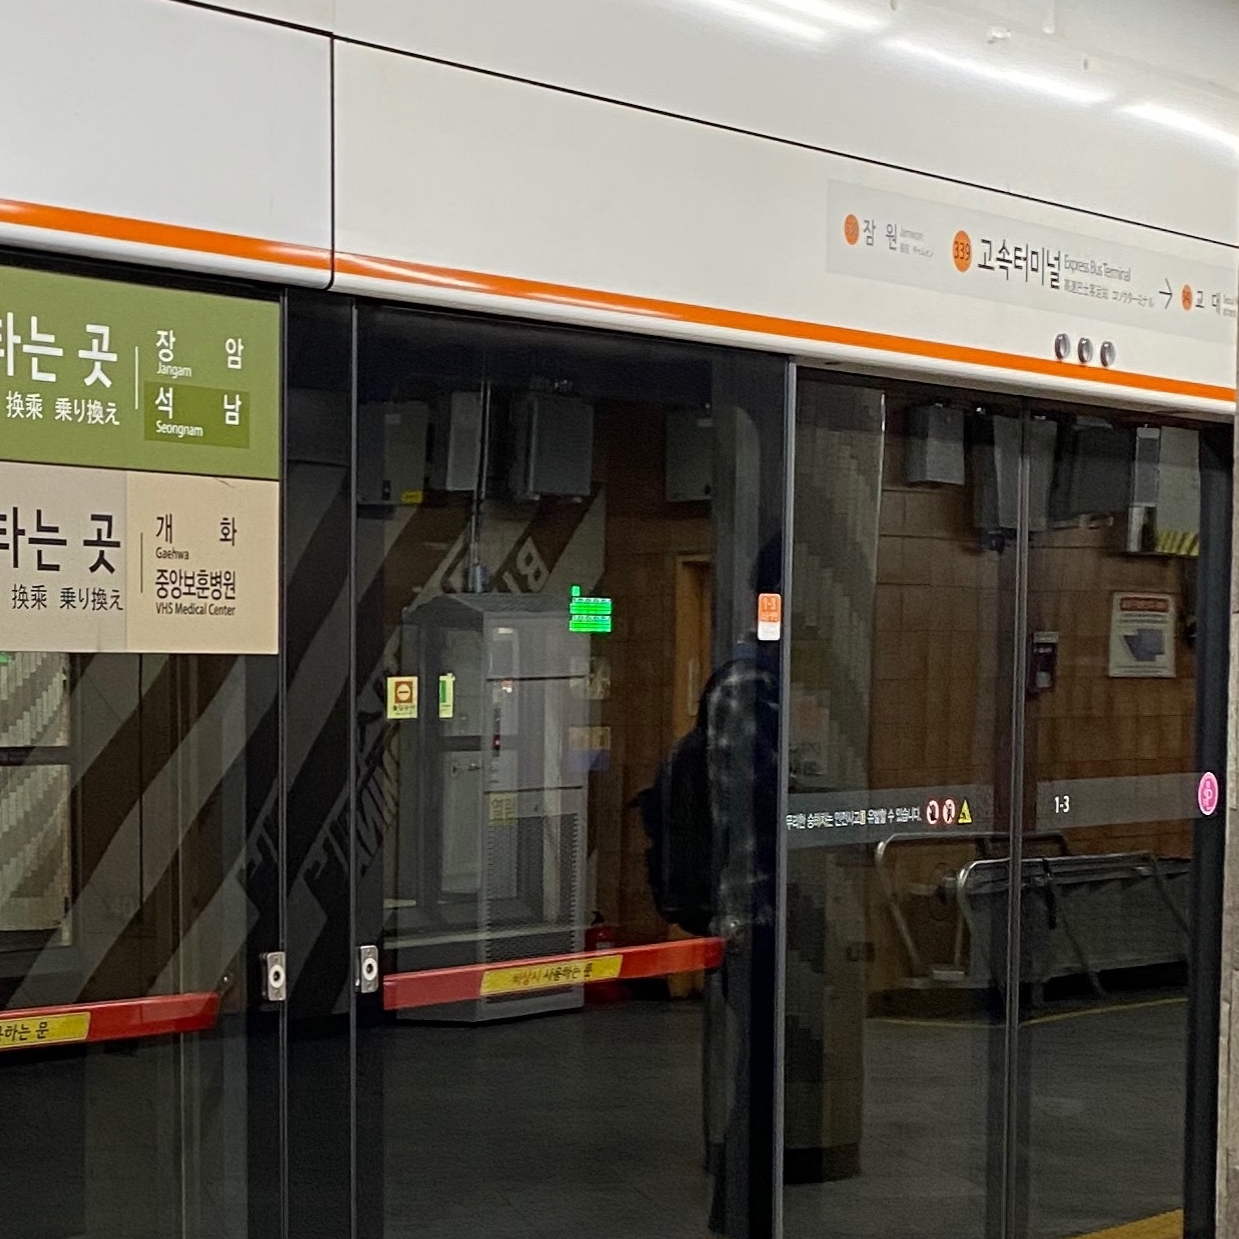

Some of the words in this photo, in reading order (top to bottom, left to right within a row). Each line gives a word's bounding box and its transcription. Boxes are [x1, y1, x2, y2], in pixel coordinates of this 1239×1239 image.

[954, 240, 971, 261] 339
[978, 239, 1061, 290] 고속터미널
[78, 323, 118, 388] 곳
[156, 329, 176, 362] 장
[225, 338, 244, 369] 암
[156, 362, 192, 379] Jangam
[54, 397, 120, 425] 乗り換え
[155, 387, 173, 420] 석
[224, 394, 242, 425] 남
[156, 420, 204, 438] Seongnam
[156, 513, 173, 544] 개
[219, 517, 237, 546] 화
[83, 514, 121, 574] 곳
[155, 546, 189, 560] Gaehwa
[155, 569, 236, 600] 중앙보훈병원
[59, 586, 124, 612] 乗り換え
[155, 602, 173, 614] VHS
[174, 602, 207, 615] Medical
[208, 603, 236, 616] Center
[1054, 795, 1070, 813] 1-3
[543, 964, 581, 982] 사용하는
[583, 962, 593, 978] 문
[35, 1021, 49, 1040] 문
